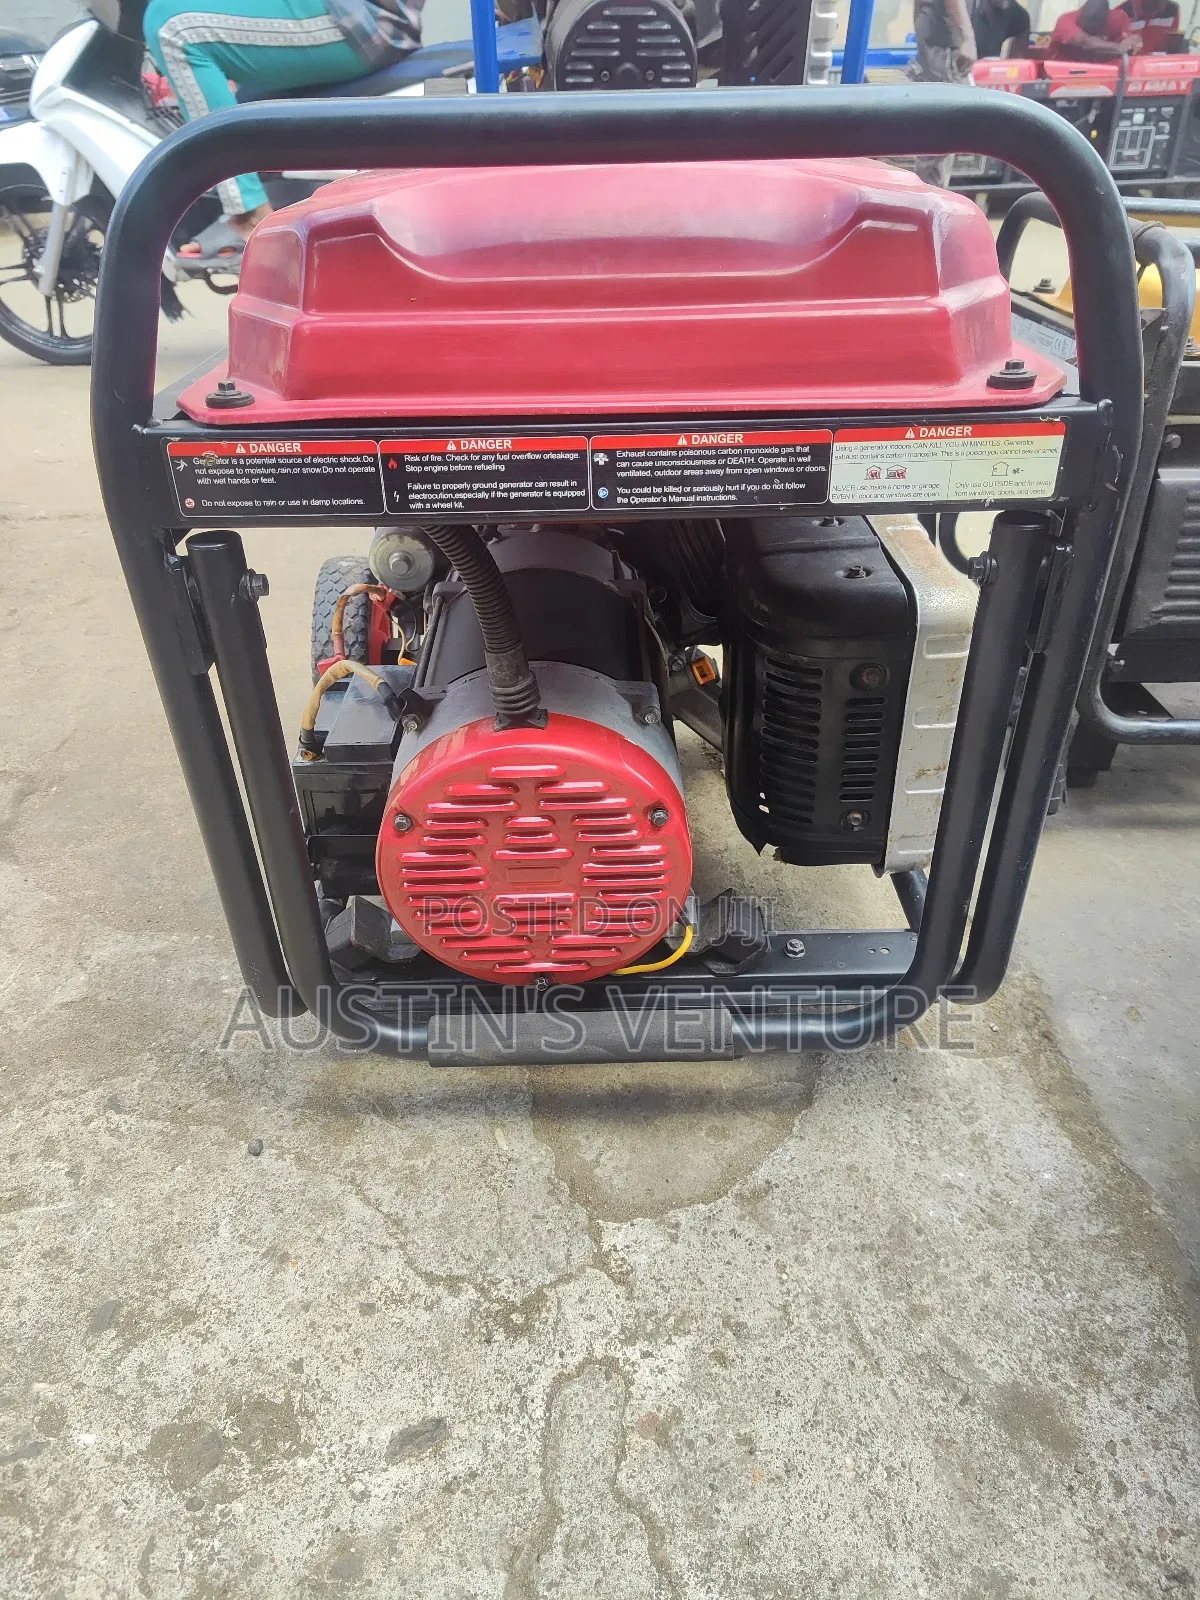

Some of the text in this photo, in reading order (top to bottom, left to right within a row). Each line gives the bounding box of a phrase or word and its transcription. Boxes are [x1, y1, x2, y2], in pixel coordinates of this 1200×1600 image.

[920, 427, 972, 437] DANGER
[692, 434, 743, 444] DANGER
[249, 443, 302, 453] DANGER
[460, 440, 512, 450] DANGER
[860, 444, 888, 452] generator
[678, 449, 716, 457] poisonous
[744, 446, 779, 454] monoxide
[781, 447, 794, 455] gas
[192, 457, 229, 465] Geator
[246, 456, 276, 466] potential
[482, 454, 495, 462] any
[512, 452, 541, 460] overflow
[758, 456, 787, 464] Operate
[208, 468, 234, 476] expose
[348, 466, 375, 474] operate
[406, 465, 422, 473] Stop
[424, 465, 448, 473] engine
[475, 463, 505, 471] refueling
[616, 469, 652, 477] ventilated,
[654, 468, 681, 476] outdoor
[705, 468, 724, 476] away
[442, 482, 470, 490] properly
[472, 482, 497, 490] ground
[499, 481, 533, 489] generator
[632, 486, 651, 494] could
[747, 484, 760, 492] you
[772, 482, 784, 490] not
[510, 490, 544, 499] generator
[553, 489, 585, 498] equipped
[630, 496, 667, 504] Operator's
